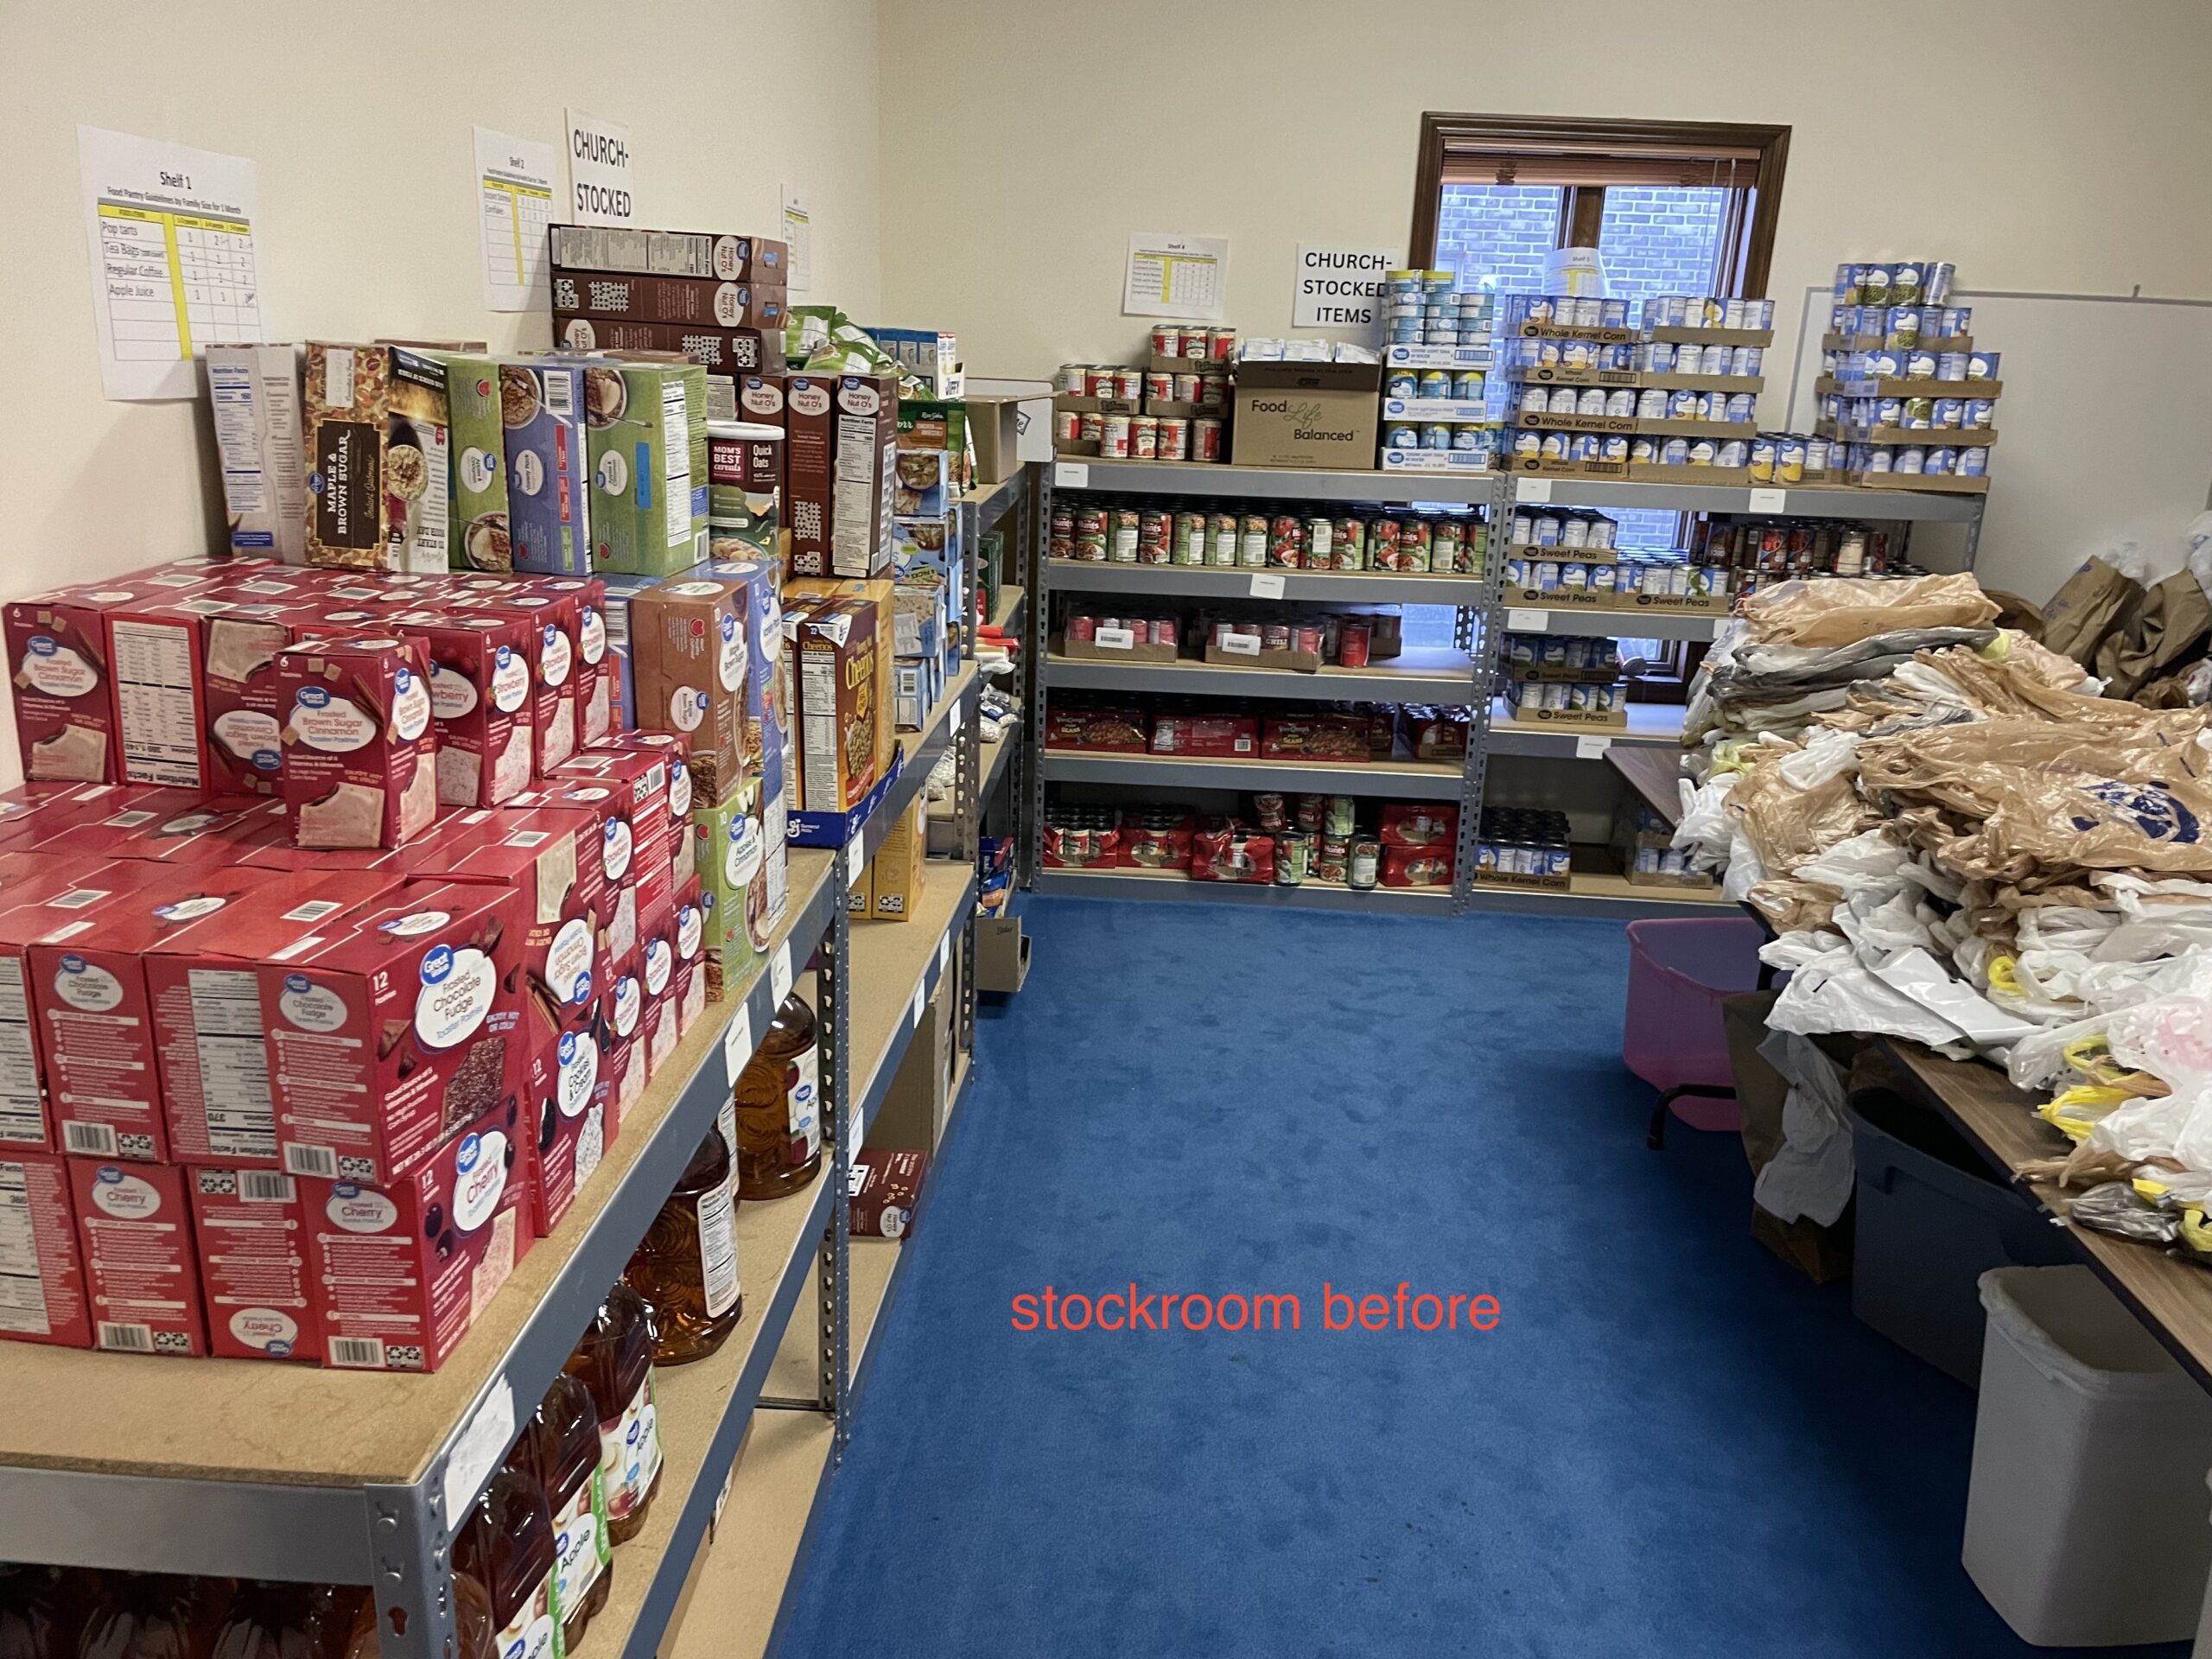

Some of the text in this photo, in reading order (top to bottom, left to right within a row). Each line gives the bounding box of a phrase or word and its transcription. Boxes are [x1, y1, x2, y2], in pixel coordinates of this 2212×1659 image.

[574, 129, 629, 168] CHURCH-
[160, 171, 192, 189] Shelf 1
[576, 182, 631, 218] STOCKED
[102, 221, 138, 236] Pop tarts
[1305, 252, 1393, 271] CHURCH-
[106, 264, 137, 277] Regular
[109, 283, 154, 297] Apple Juice
[1303, 279, 1388, 298] STOCKED
[1316, 307, 1372, 324] ITEMS
[1540, 327, 1626, 340] Whole Kernel Corn
[752, 391, 775, 401] Honey
[798, 393, 821, 402] Honey
[848, 392, 871, 402] Honey
[1251, 399, 1324, 430] Food Life
[1541, 417, 1632, 430] Whole Kernel Corn
[1294, 429, 1354, 442] Balanced
[714, 446, 741, 454] MOM'S
[753, 444, 772, 456] Quick
[714, 454, 741, 463] BEST
[753, 457, 769, 467] Oats
[714, 463, 741, 472] cereals
[337, 429, 351, 535] BROWN SUGAR
[327, 466, 338, 513] MAPLE
[1540, 549, 1598, 559] Sweet Peas
[1540, 591, 1597, 602] Sweet Peas
[1653, 597, 1709, 607] Sweet Peas
[13, 608, 21, 618] 6
[802, 641, 833, 651] Cheerios
[280, 657, 289, 667] 6
[846, 649, 874, 690] Cheerios
[1554, 711, 1608, 721] Sweet Peas
[302, 718, 363, 729] Brown Sugar
[308, 727, 359, 735] Cinnamon
[126, 770, 200, 787] Nutrition Facts
[1479, 874, 1566, 887] Whole Kernel Corn
[424, 952, 448, 973] Great
[373, 971, 388, 991] 12
[443, 970, 470, 994] Frosted
[434, 976, 481, 1012] Chocolate
[293, 1000, 334, 1011] Chocolate
[445, 995, 474, 1020] Fudge
[437, 1020, 460, 1039] Toaster
[532, 1058, 542, 1076] 12
[422, 1169, 433, 1189] 12
[467, 1160, 499, 1204] Cherry
[106, 1192, 146, 1205] Cherry
[341, 1206, 382, 1218] Cherry
[243, 1321, 283, 1332] Cherry
[561, 1529, 590, 1573] Apple
